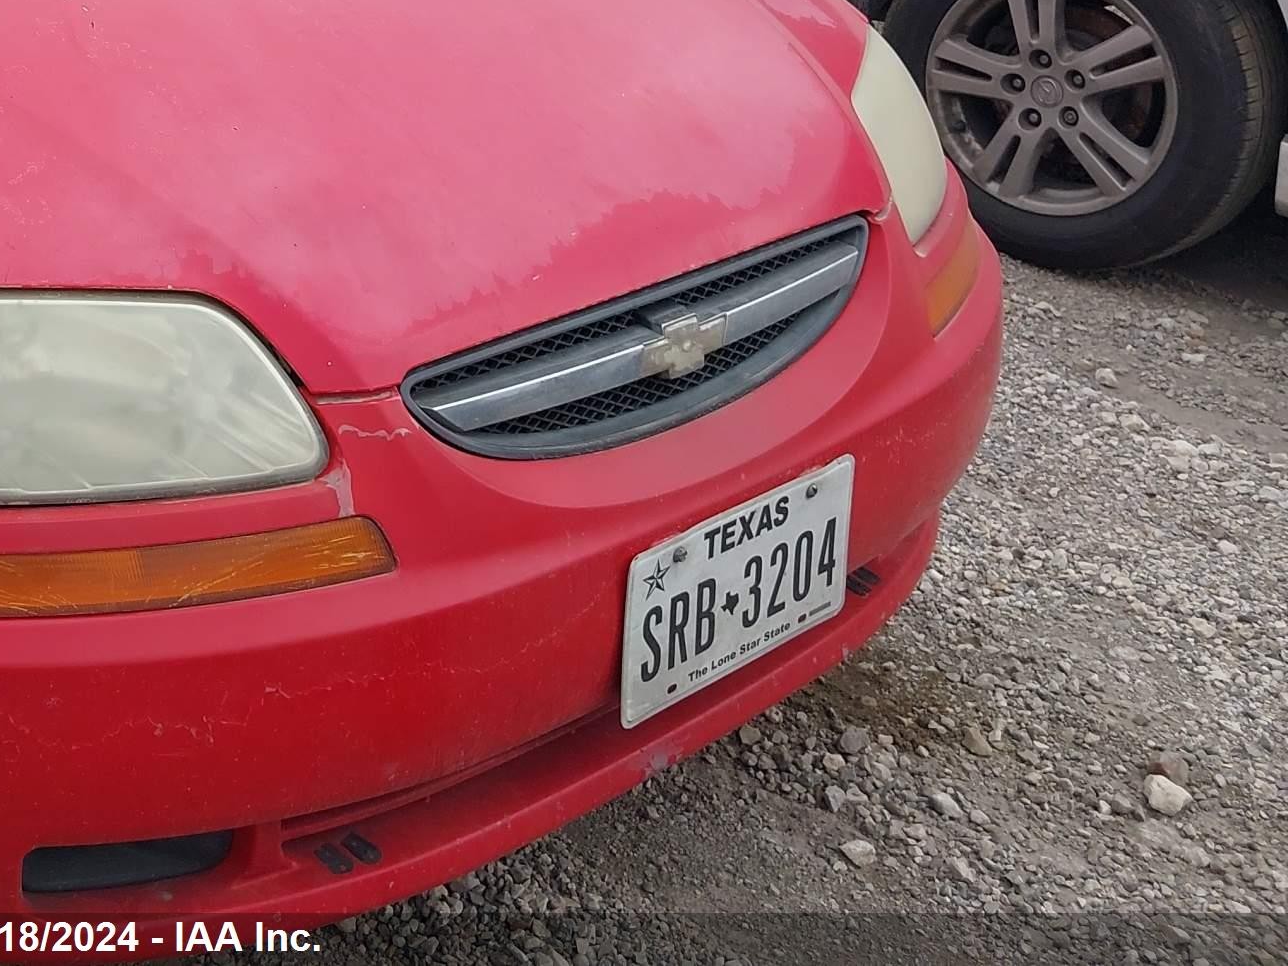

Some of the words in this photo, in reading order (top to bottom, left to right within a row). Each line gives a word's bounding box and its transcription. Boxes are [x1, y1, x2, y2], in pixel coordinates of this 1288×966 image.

[703, 495, 790, 560] TEXAS
[640, 577, 717, 683] SRB
[741, 516, 838, 629] 3204
[687, 666, 709, 682] The
[711, 650, 737, 671] Lone
[739, 637, 762, 655] Star
[763, 622, 792, 643] State
